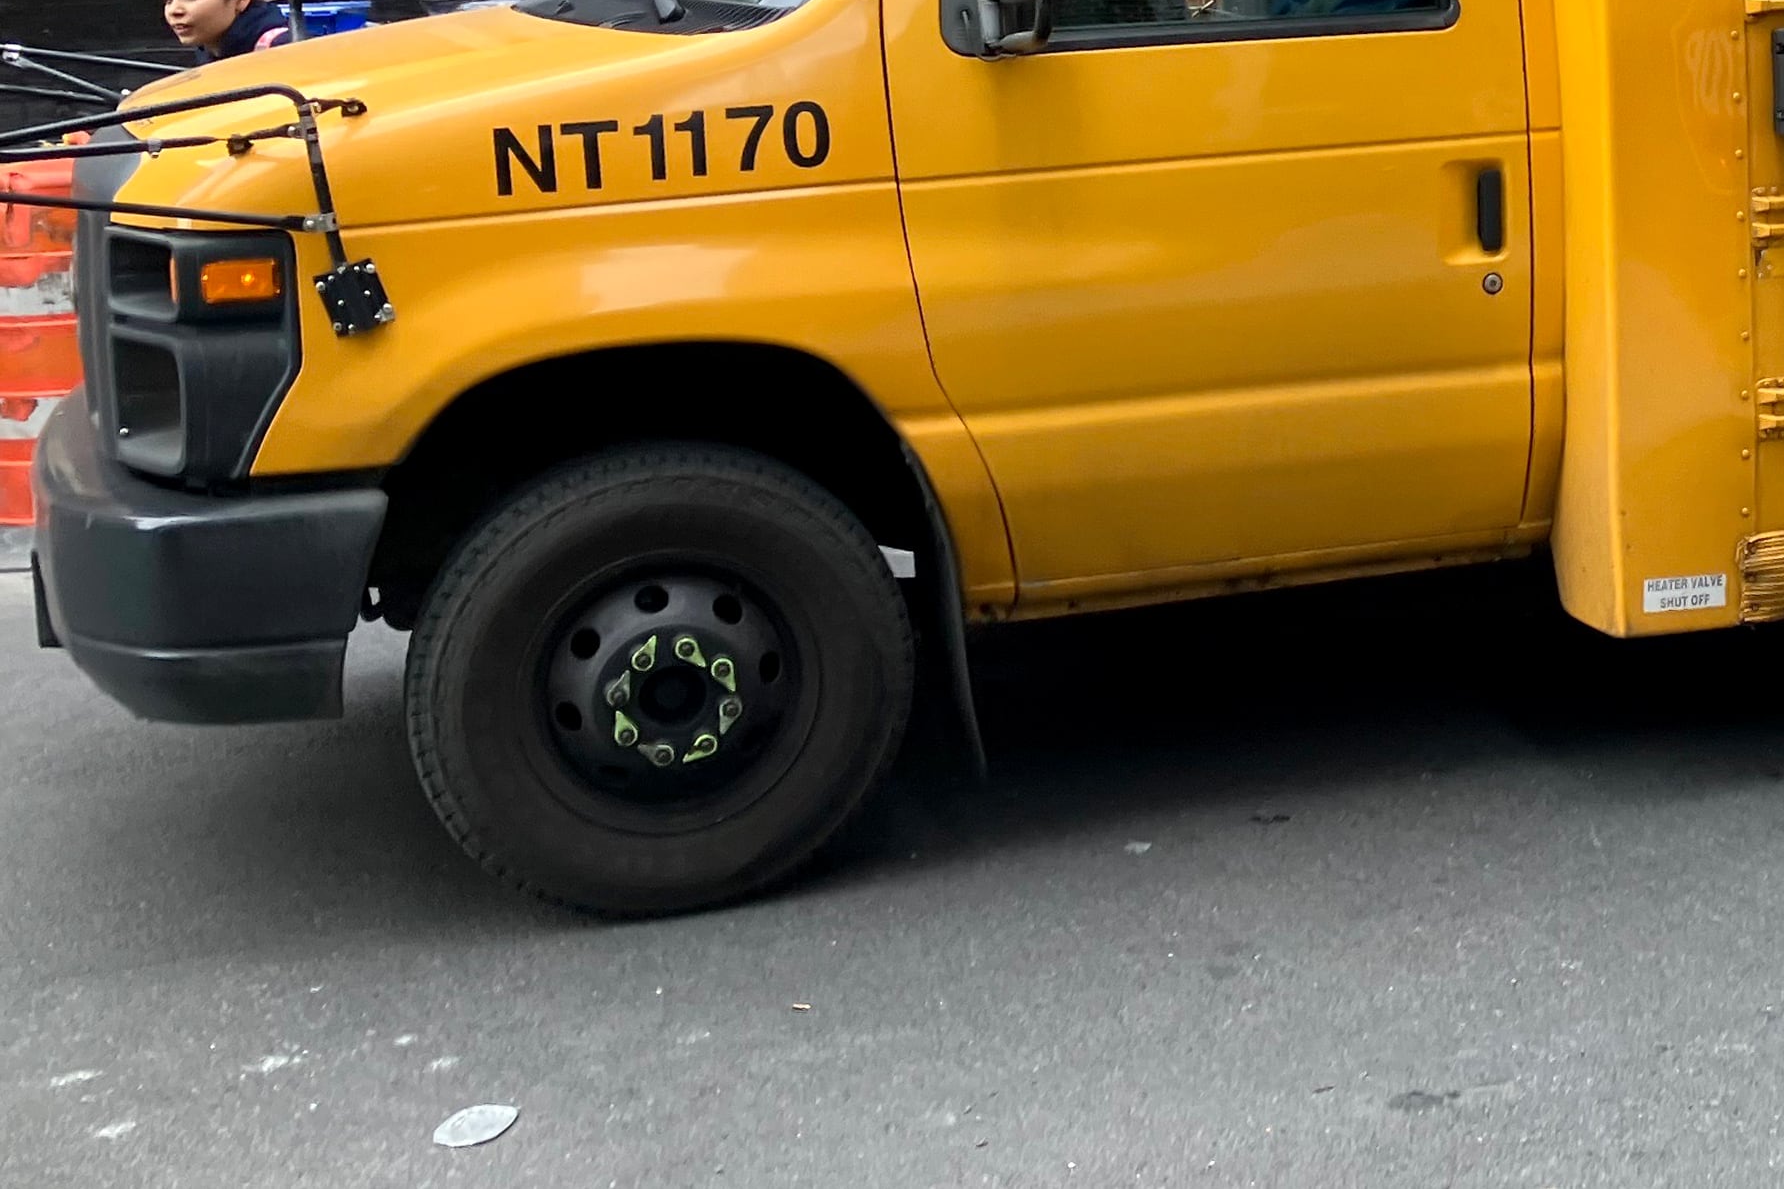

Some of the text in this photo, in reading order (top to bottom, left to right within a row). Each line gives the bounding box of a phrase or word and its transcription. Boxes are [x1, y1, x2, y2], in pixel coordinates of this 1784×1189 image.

[493, 101, 831, 197] NT1170
[1647, 574, 1723, 592] HEATER VALVE
[1660, 594, 1710, 608] SHUT OFF
